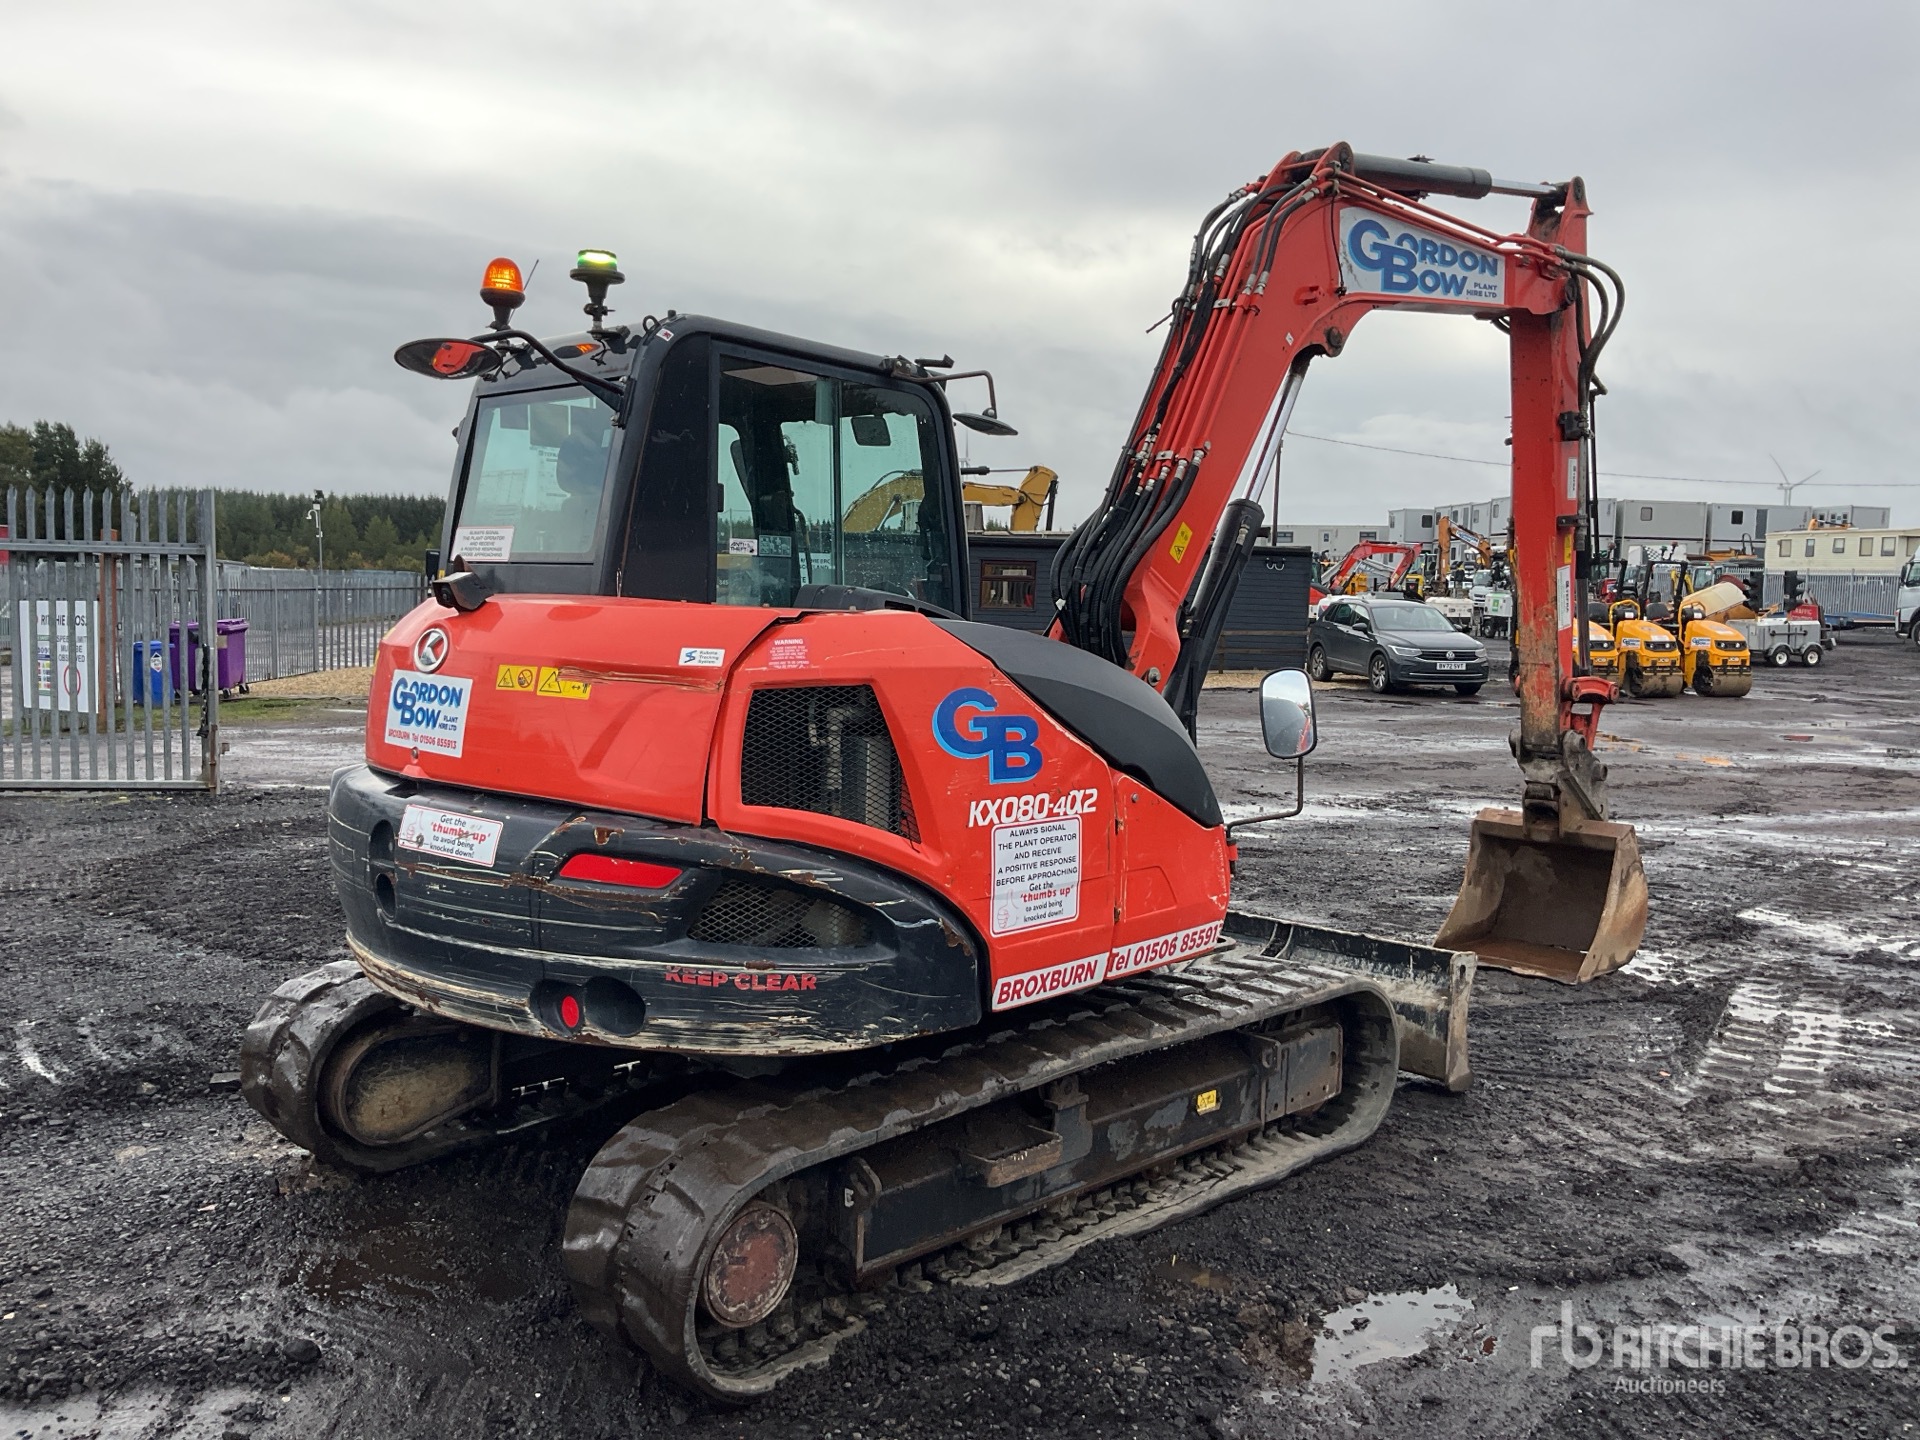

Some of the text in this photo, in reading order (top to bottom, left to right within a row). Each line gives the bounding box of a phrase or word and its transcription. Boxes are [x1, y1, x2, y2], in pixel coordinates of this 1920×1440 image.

[1348, 219, 1498, 276] GORDON
[1374, 243, 1468, 297] BOW
[1466, 289, 1483, 297] HIRE
[1473, 282, 1498, 291] PLANT
[774, 638, 804, 646] WARNING
[393, 677, 464, 712] GORDON
[400, 691, 442, 729] BOW
[419, 734, 436, 746] 01506
[436, 737, 457, 750] 855913
[440, 814, 467, 827] Get the
[1009, 824, 1067, 838] ALWAYS SIGNAL
[429, 842, 475, 858] knocked down!
[433, 834, 475, 851] to avoid being
[998, 833, 1077, 851] THE PLANT OPERATOR
[1014, 847, 1062, 860] AND RECEIVE
[998, 856, 1077, 875] A POSITIVE RESPONSE
[996, 866, 1078, 887] BEFORE APPROACHING
[1029, 881, 1054, 892] Get the
[1025, 899, 1063, 913] to avoid being
[1023, 908, 1064, 923] knocked down!
[664, 965, 817, 991] KEEP CLEAR
[997, 959, 1098, 1005] BROXBURN
[1108, 949, 1130, 972] Tel
[1133, 936, 1178, 965] 01506
